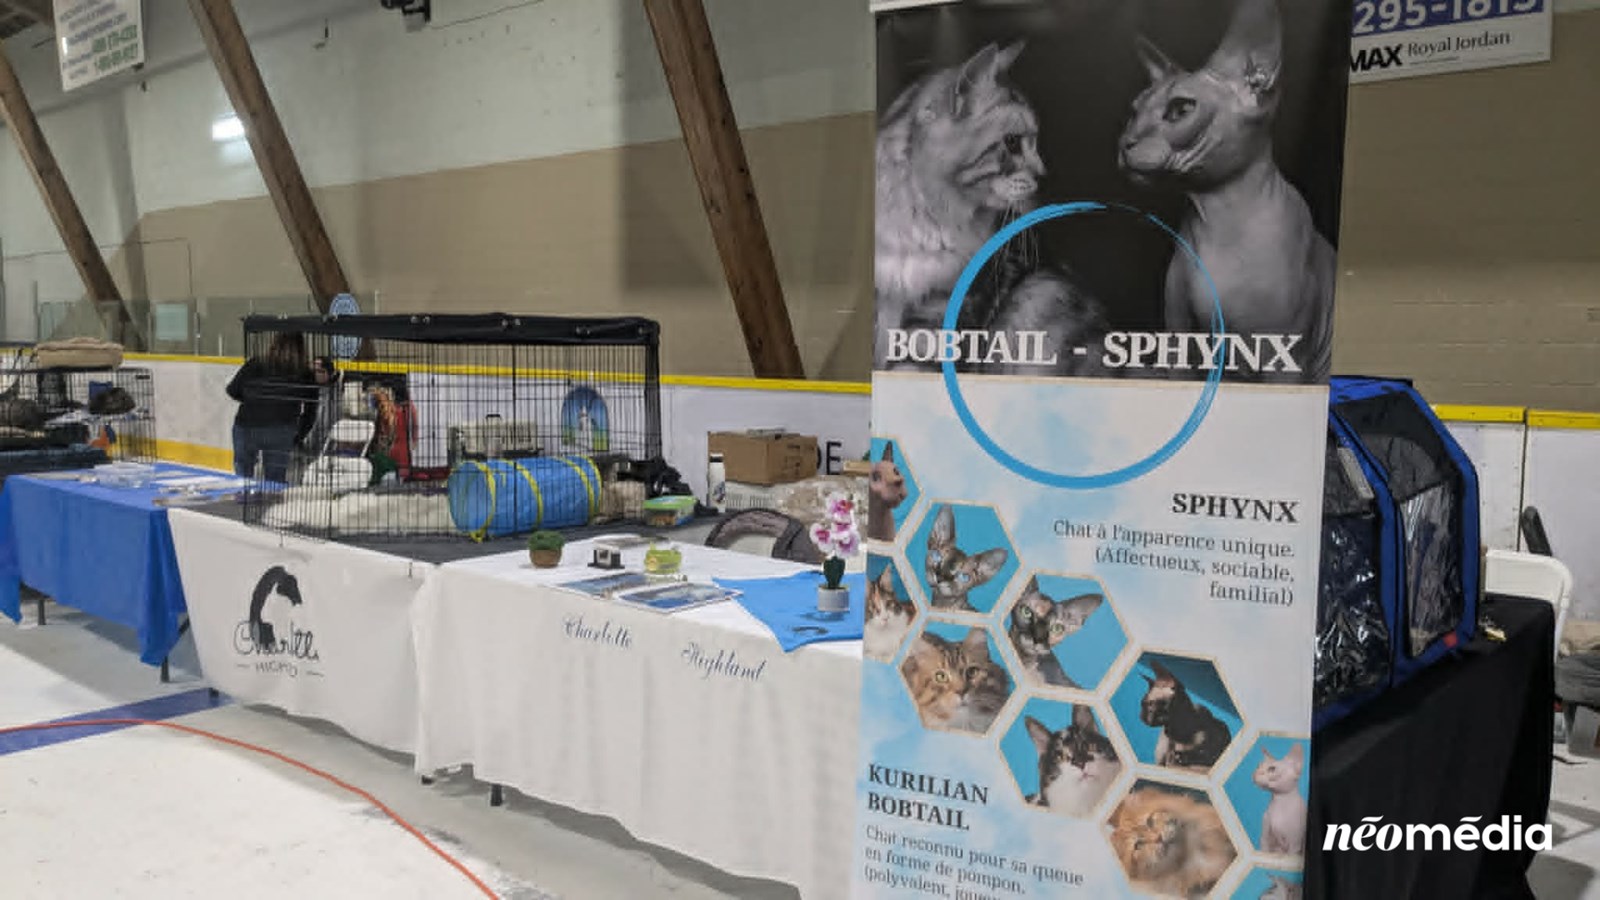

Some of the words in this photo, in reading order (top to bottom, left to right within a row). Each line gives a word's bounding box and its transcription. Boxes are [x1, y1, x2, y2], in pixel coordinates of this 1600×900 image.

[1408, 37, 1450, 57] Royal
[1456, 31, 1511, 52] Jordan
[886, 329, 1057, 366] BOBTAIL
[1102, 331, 1302, 373] SPHYNX
[1172, 492, 1299, 524] SPHYNX
[1053, 519, 1091, 538] Chat
[1097, 523, 1107, 540] à
[1112, 524, 1215, 551] l'apparence
[1222, 536, 1295, 561] unique.
[1095, 546, 1205, 576] (Affectueux,
[1212, 559, 1295, 583] sociable,
[1209, 580, 1294, 607] familial)
[563, 612, 633, 649] Charlotte
[682, 642, 767, 682] Highland
[868, 763, 989, 805] KURILIAN
[867, 791, 970, 831] BOBTAIL
[865, 849, 881, 862] en
[886, 849, 931, 872] forme
[935, 860, 953, 876] de
[957, 868, 1026, 895] pompon.
[866, 824, 897, 844] Chat
[902, 834, 963, 859] reconnu
[969, 849, 1006, 870] pour
[1011, 860, 1028, 874] sa
[1033, 865, 1084, 886] queue
[864, 864, 950, 898] (polyvalent,
